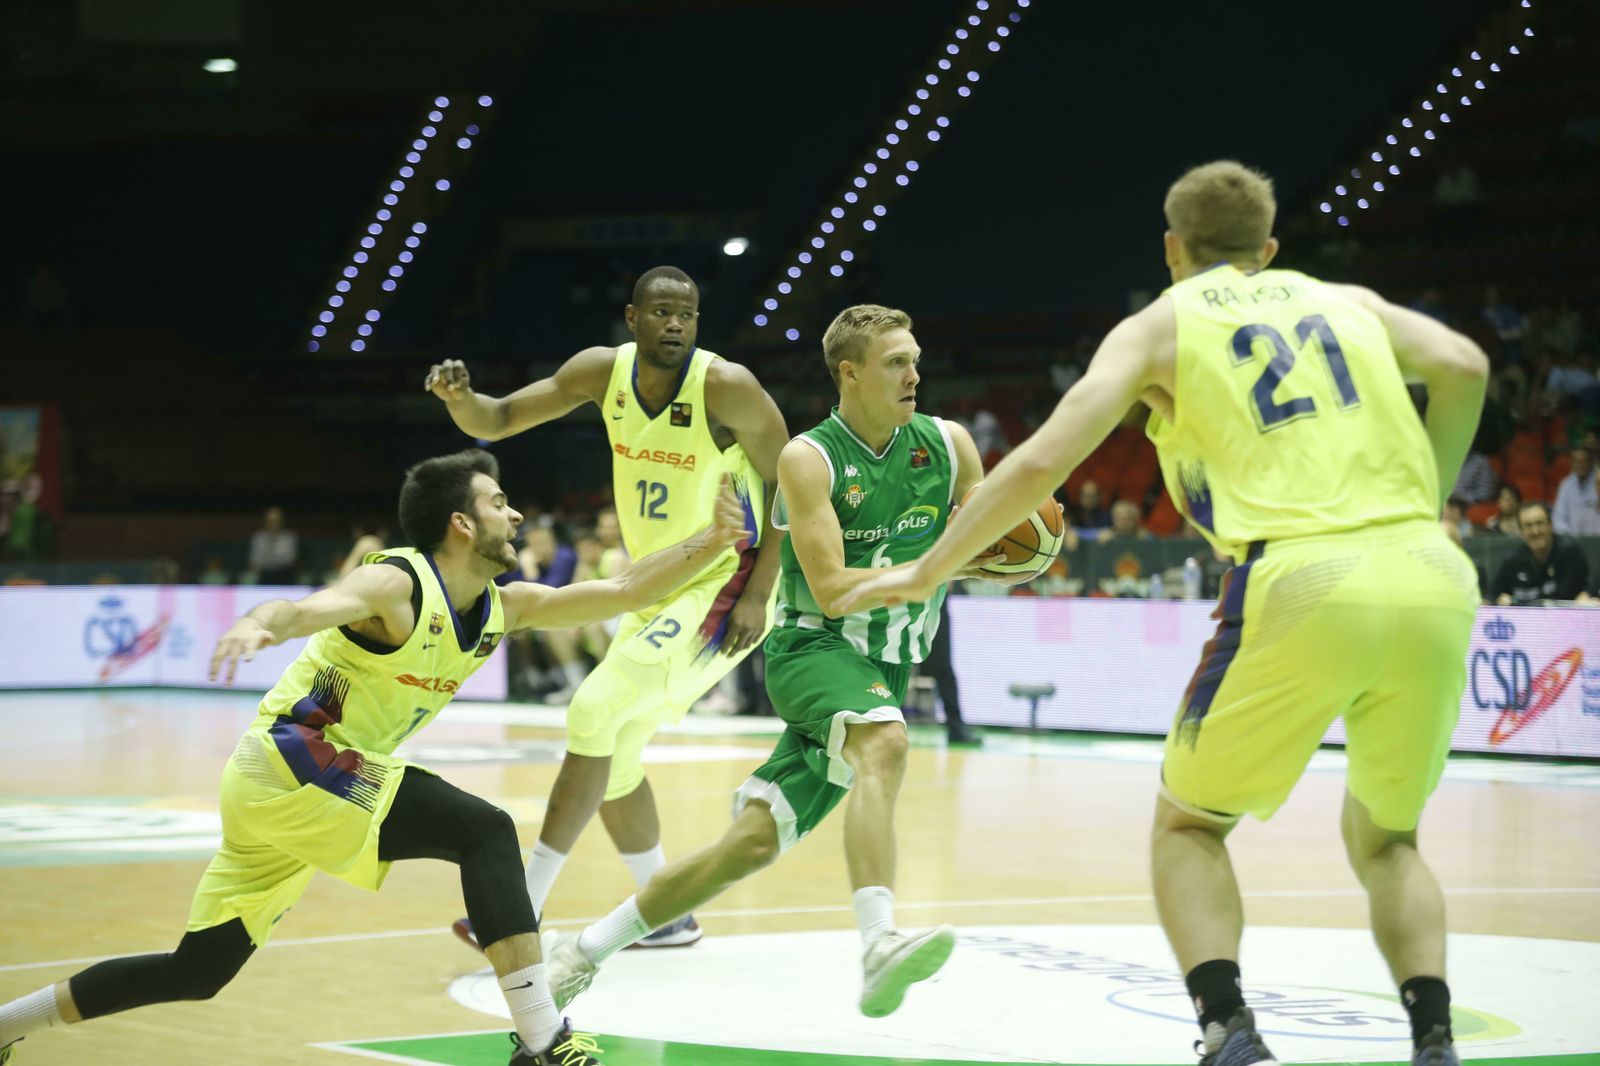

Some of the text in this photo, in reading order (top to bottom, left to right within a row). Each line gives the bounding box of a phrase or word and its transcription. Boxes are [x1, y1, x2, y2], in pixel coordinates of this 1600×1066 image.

[1227, 314, 1361, 434] 21
[624, 447, 696, 467] LASSA
[635, 479, 669, 520] 12
[841, 515, 930, 543] ergía plus
[870, 543, 893, 569] 6
[1471, 649, 1531, 710] CSD
[393, 706, 432, 744] 7
